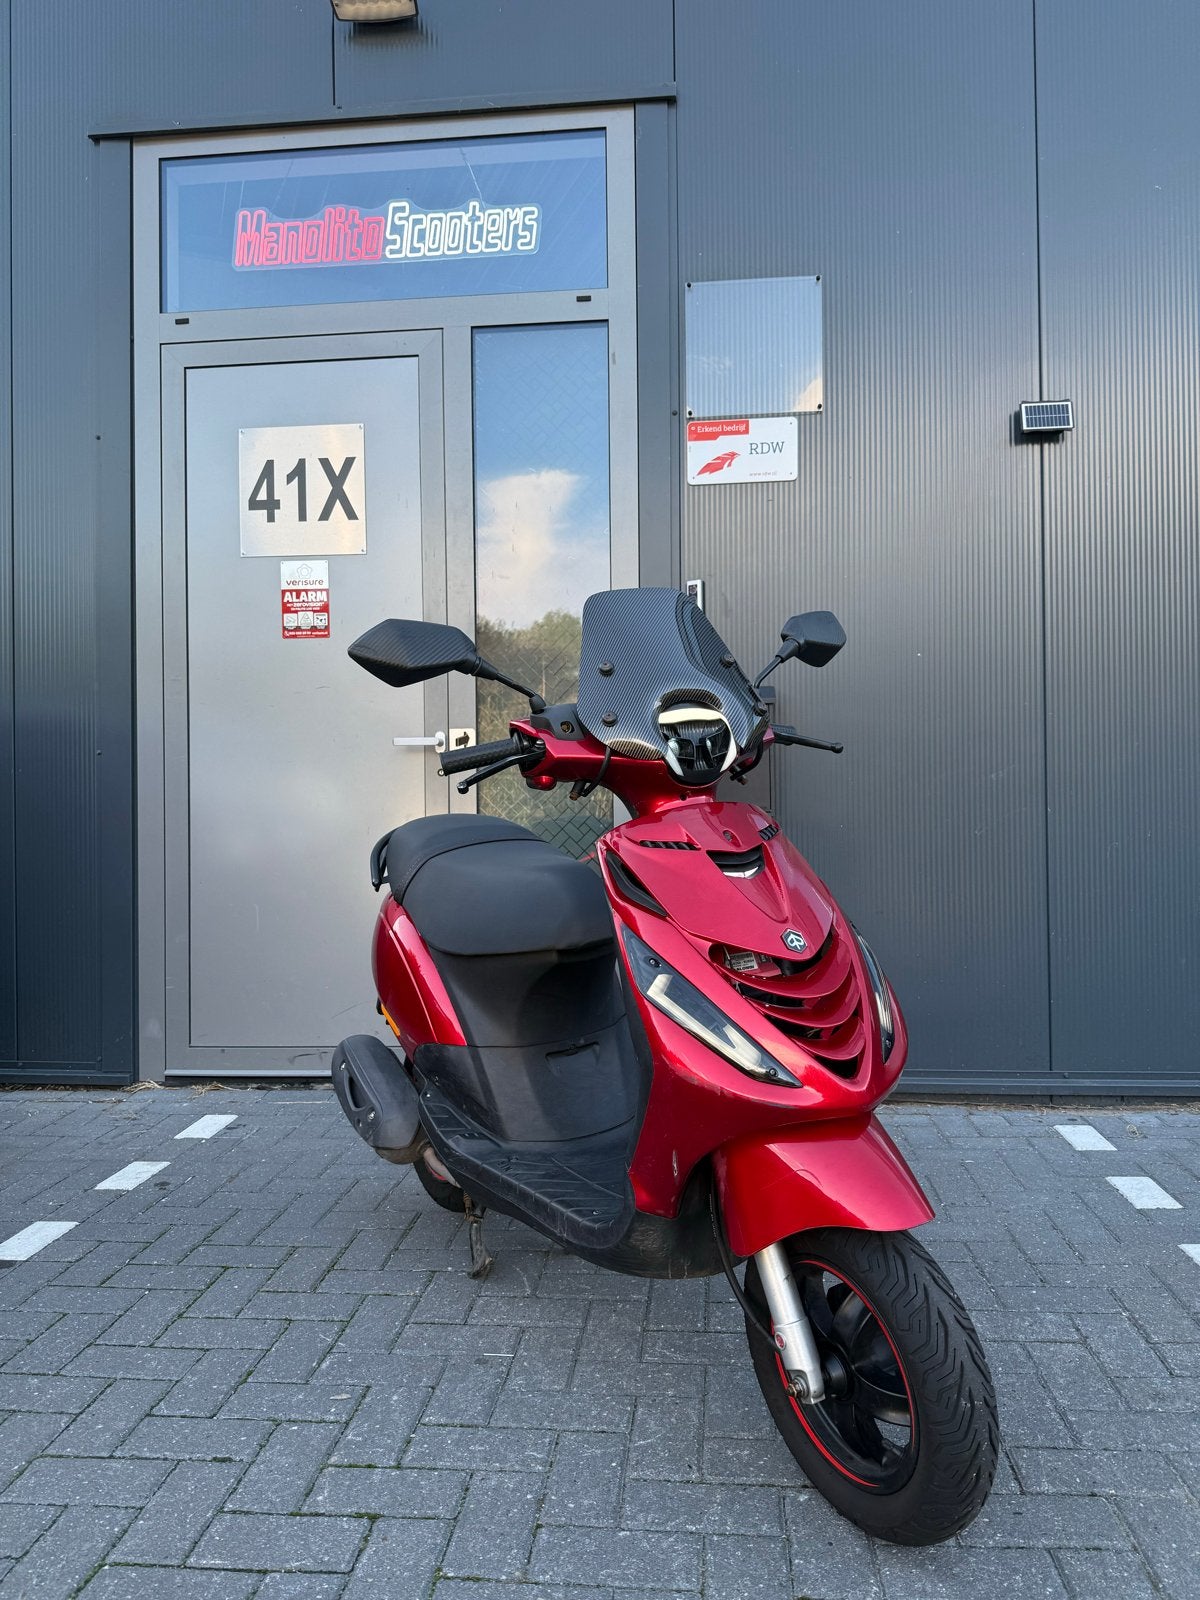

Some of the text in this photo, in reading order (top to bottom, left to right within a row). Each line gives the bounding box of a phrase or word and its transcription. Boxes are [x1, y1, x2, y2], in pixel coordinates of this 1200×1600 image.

[697, 423, 746, 433] Erkend bedrijf
[749, 441, 785, 455] RDW
[248, 456, 360, 523] 41X
[284, 592, 327, 602] ALARM
